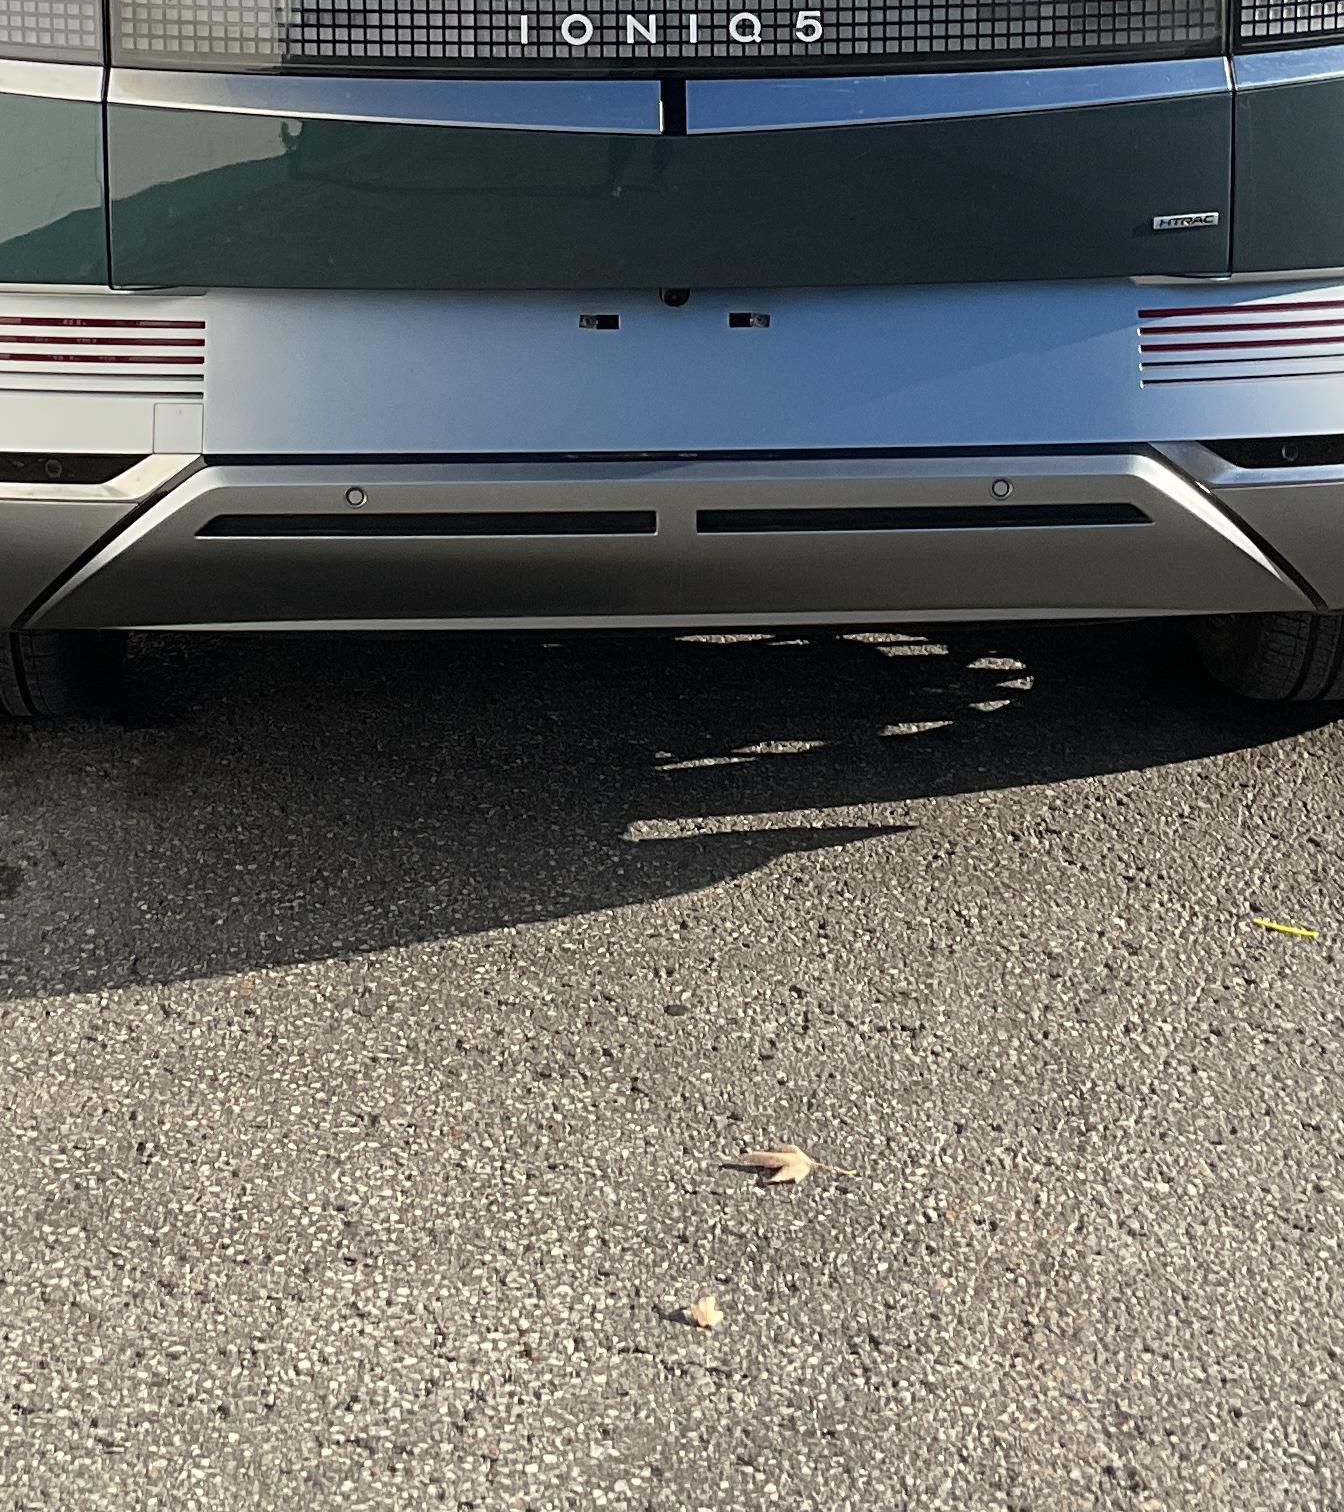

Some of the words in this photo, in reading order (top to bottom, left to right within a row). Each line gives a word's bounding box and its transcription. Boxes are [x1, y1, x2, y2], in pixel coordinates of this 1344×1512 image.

[520, 11, 763, 46] IONIQ
[794, 10, 824, 44] 5
[1158, 214, 1216, 228] HTRAC
